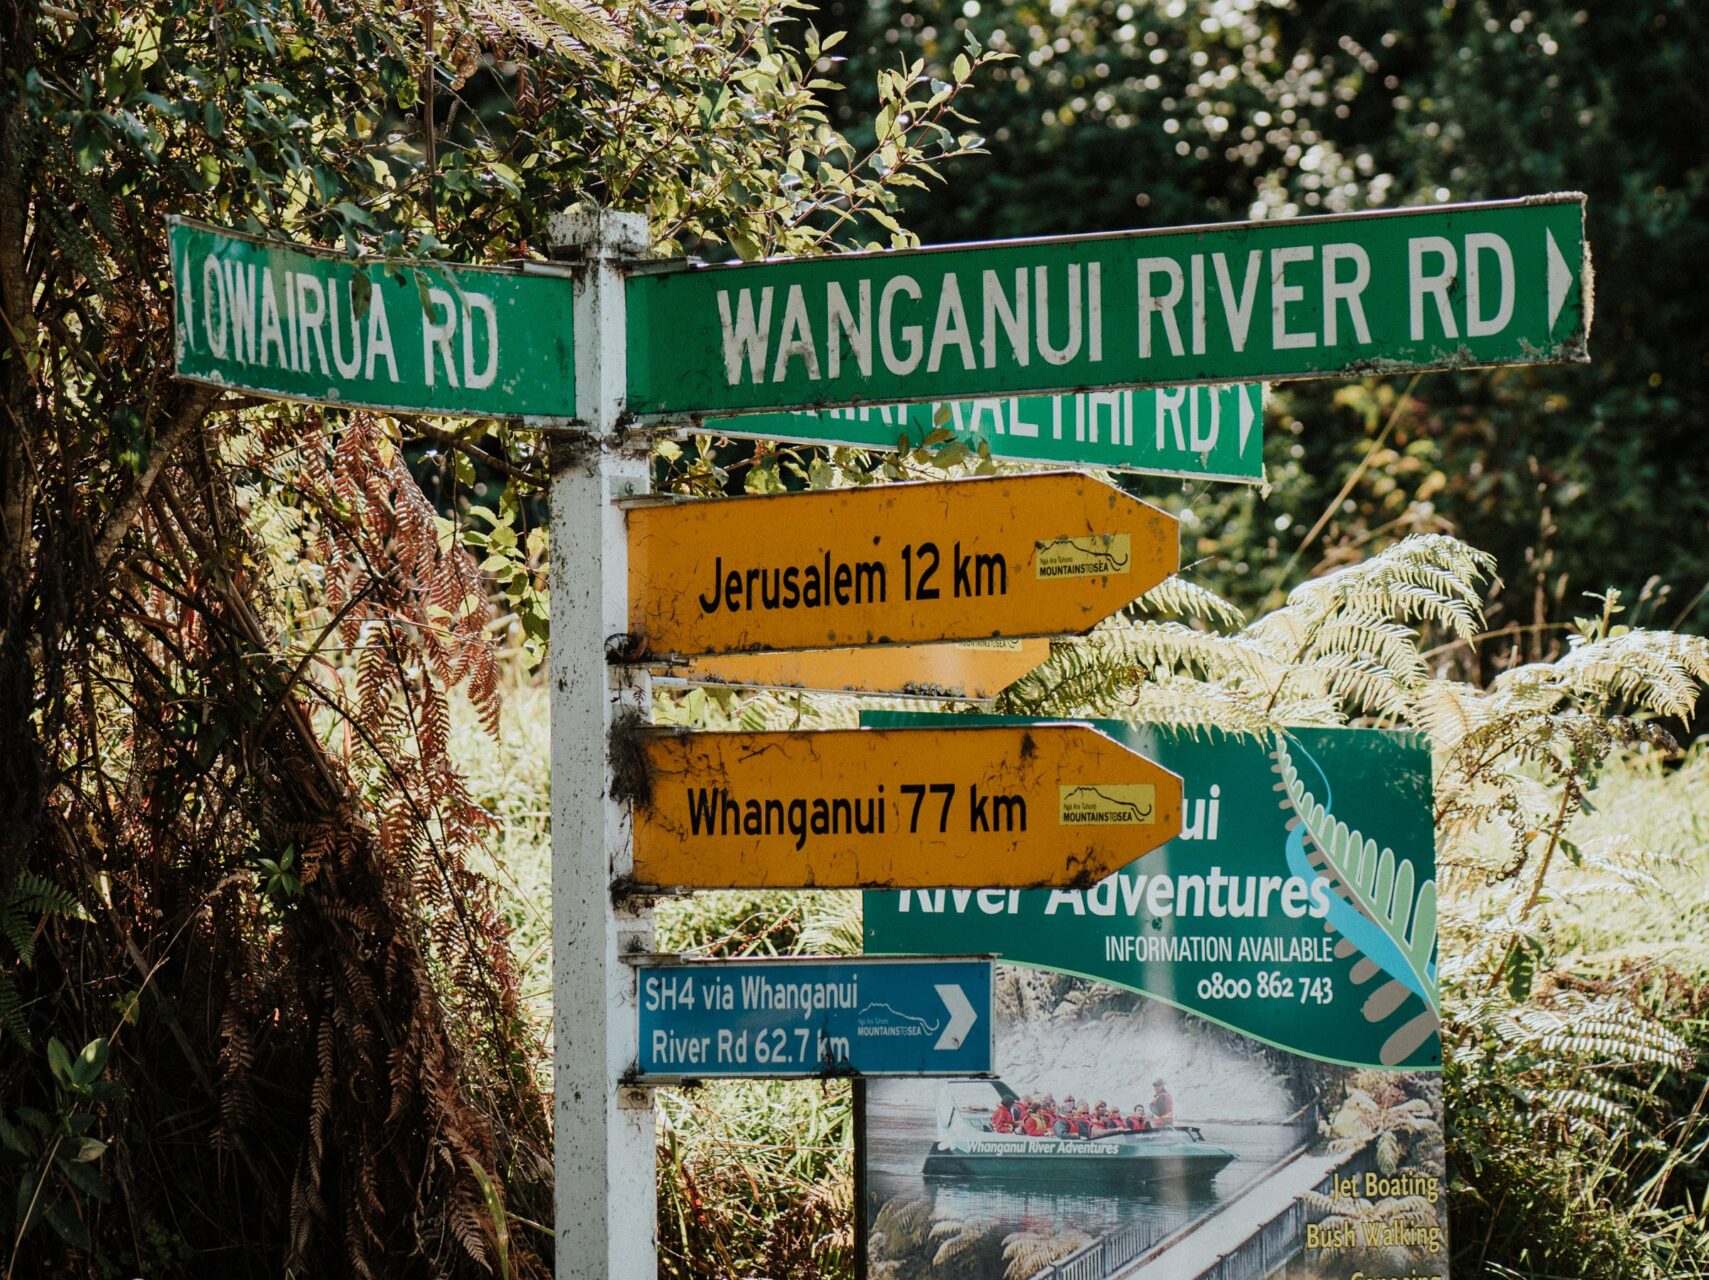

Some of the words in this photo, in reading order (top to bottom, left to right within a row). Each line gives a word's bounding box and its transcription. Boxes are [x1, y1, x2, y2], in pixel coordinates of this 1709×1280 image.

[204, 254, 400, 382] OWAIRUA
[422, 289, 499, 390] RD
[716, 261, 1103, 385] WANGANUI
[1137, 242, 1372, 359] RIVER
[1408, 232, 1516, 341] RD
[699, 550, 887, 614] Jerusalem
[902, 542, 941, 601] 12
[954, 541, 1007, 598] km
[687, 784, 885, 851] Whanganui
[900, 784, 956, 833] 77
[970, 783, 1027, 832] km
[1044, 866, 1331, 918] Adventures
[1105, 935, 1232, 962] INFORMATION
[1237, 937, 1333, 962] AVAILABLE
[645, 976, 695, 1011] SH4
[702, 976, 734, 1010] via
[741, 974, 858, 1020] Whanganui
[1197, 972, 1251, 1000] 0800
[1257, 971, 1294, 998] 862
[1298, 977, 1334, 1005] 743
[652, 1029, 710, 1064] River
[717, 1029, 747, 1064] Rd
[754, 1028, 810, 1063] 62.7
[816, 1029, 850, 1062] km
[1028, 1141, 1055, 1153] River
[1057, 1142, 1119, 1154] Adventures
[1332, 1172, 1359, 1205] Jet
[1365, 1170, 1438, 1204] Boating
[1306, 1220, 1356, 1249] Bush
[1361, 1219, 1440, 1253] Walking
